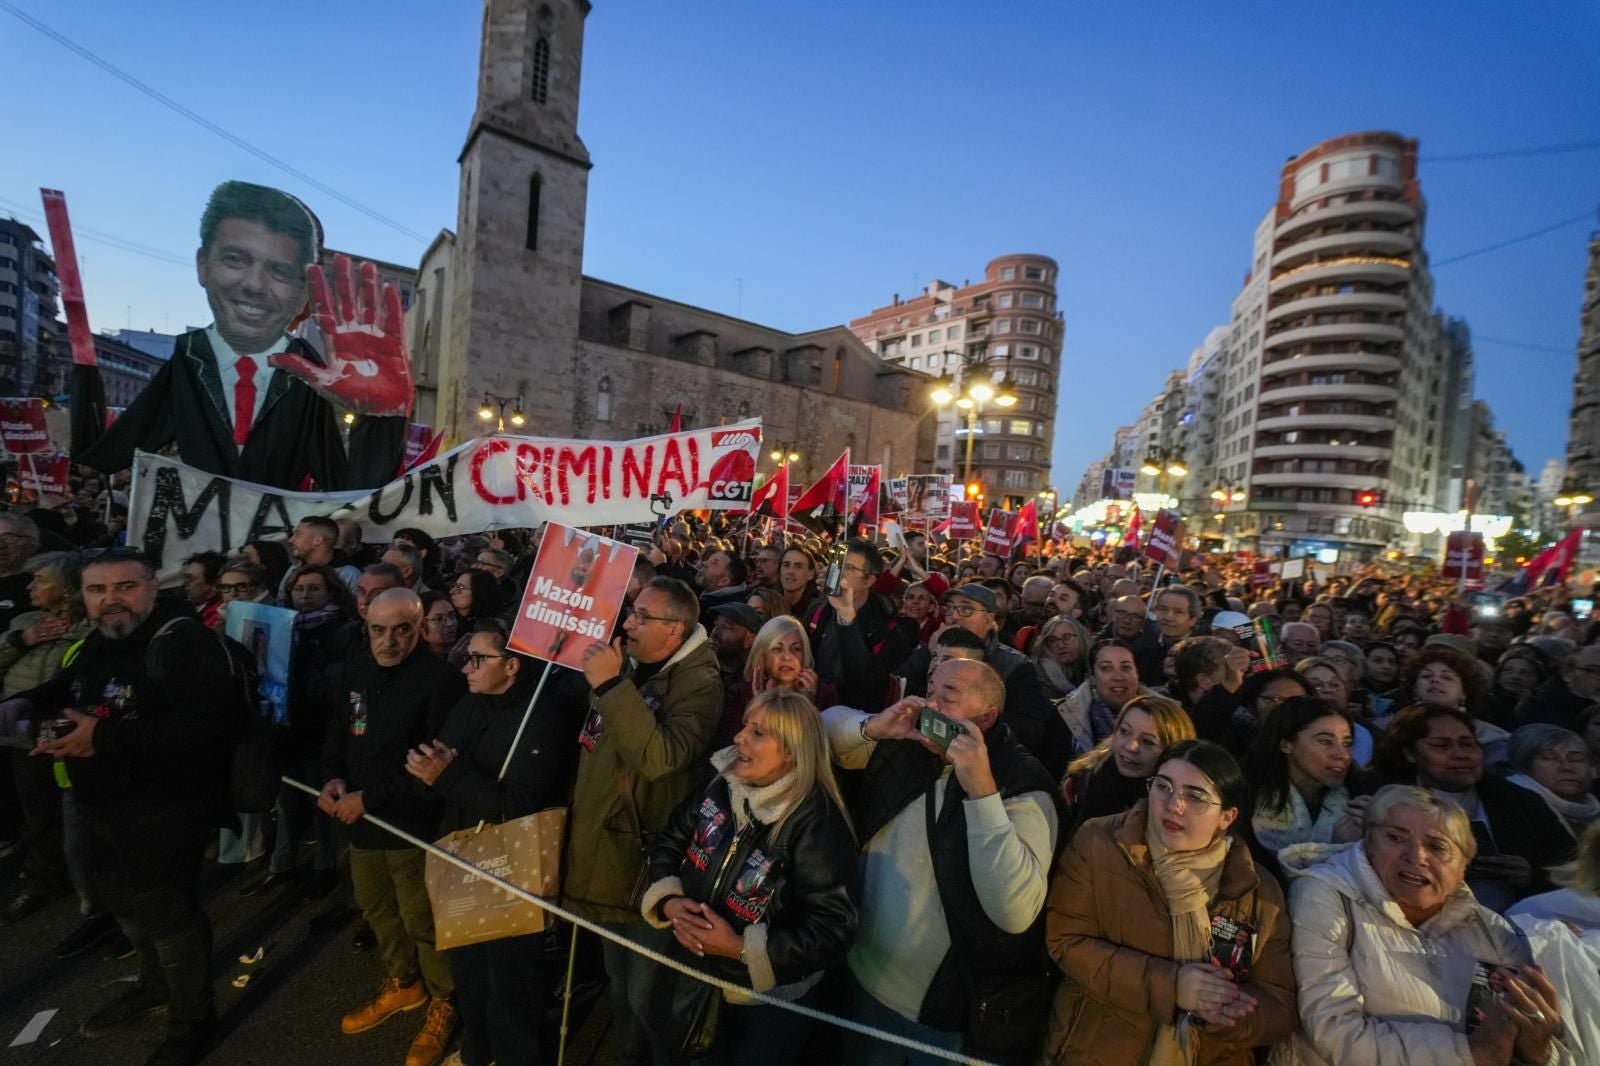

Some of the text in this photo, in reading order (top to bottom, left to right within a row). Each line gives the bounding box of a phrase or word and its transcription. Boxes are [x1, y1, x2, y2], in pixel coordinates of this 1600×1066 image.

[143, 437, 708, 571] MAON CRIMINAL
[711, 480, 752, 499] CGT
[533, 576, 598, 611] Mazón
[526, 600, 607, 640] dimissió
